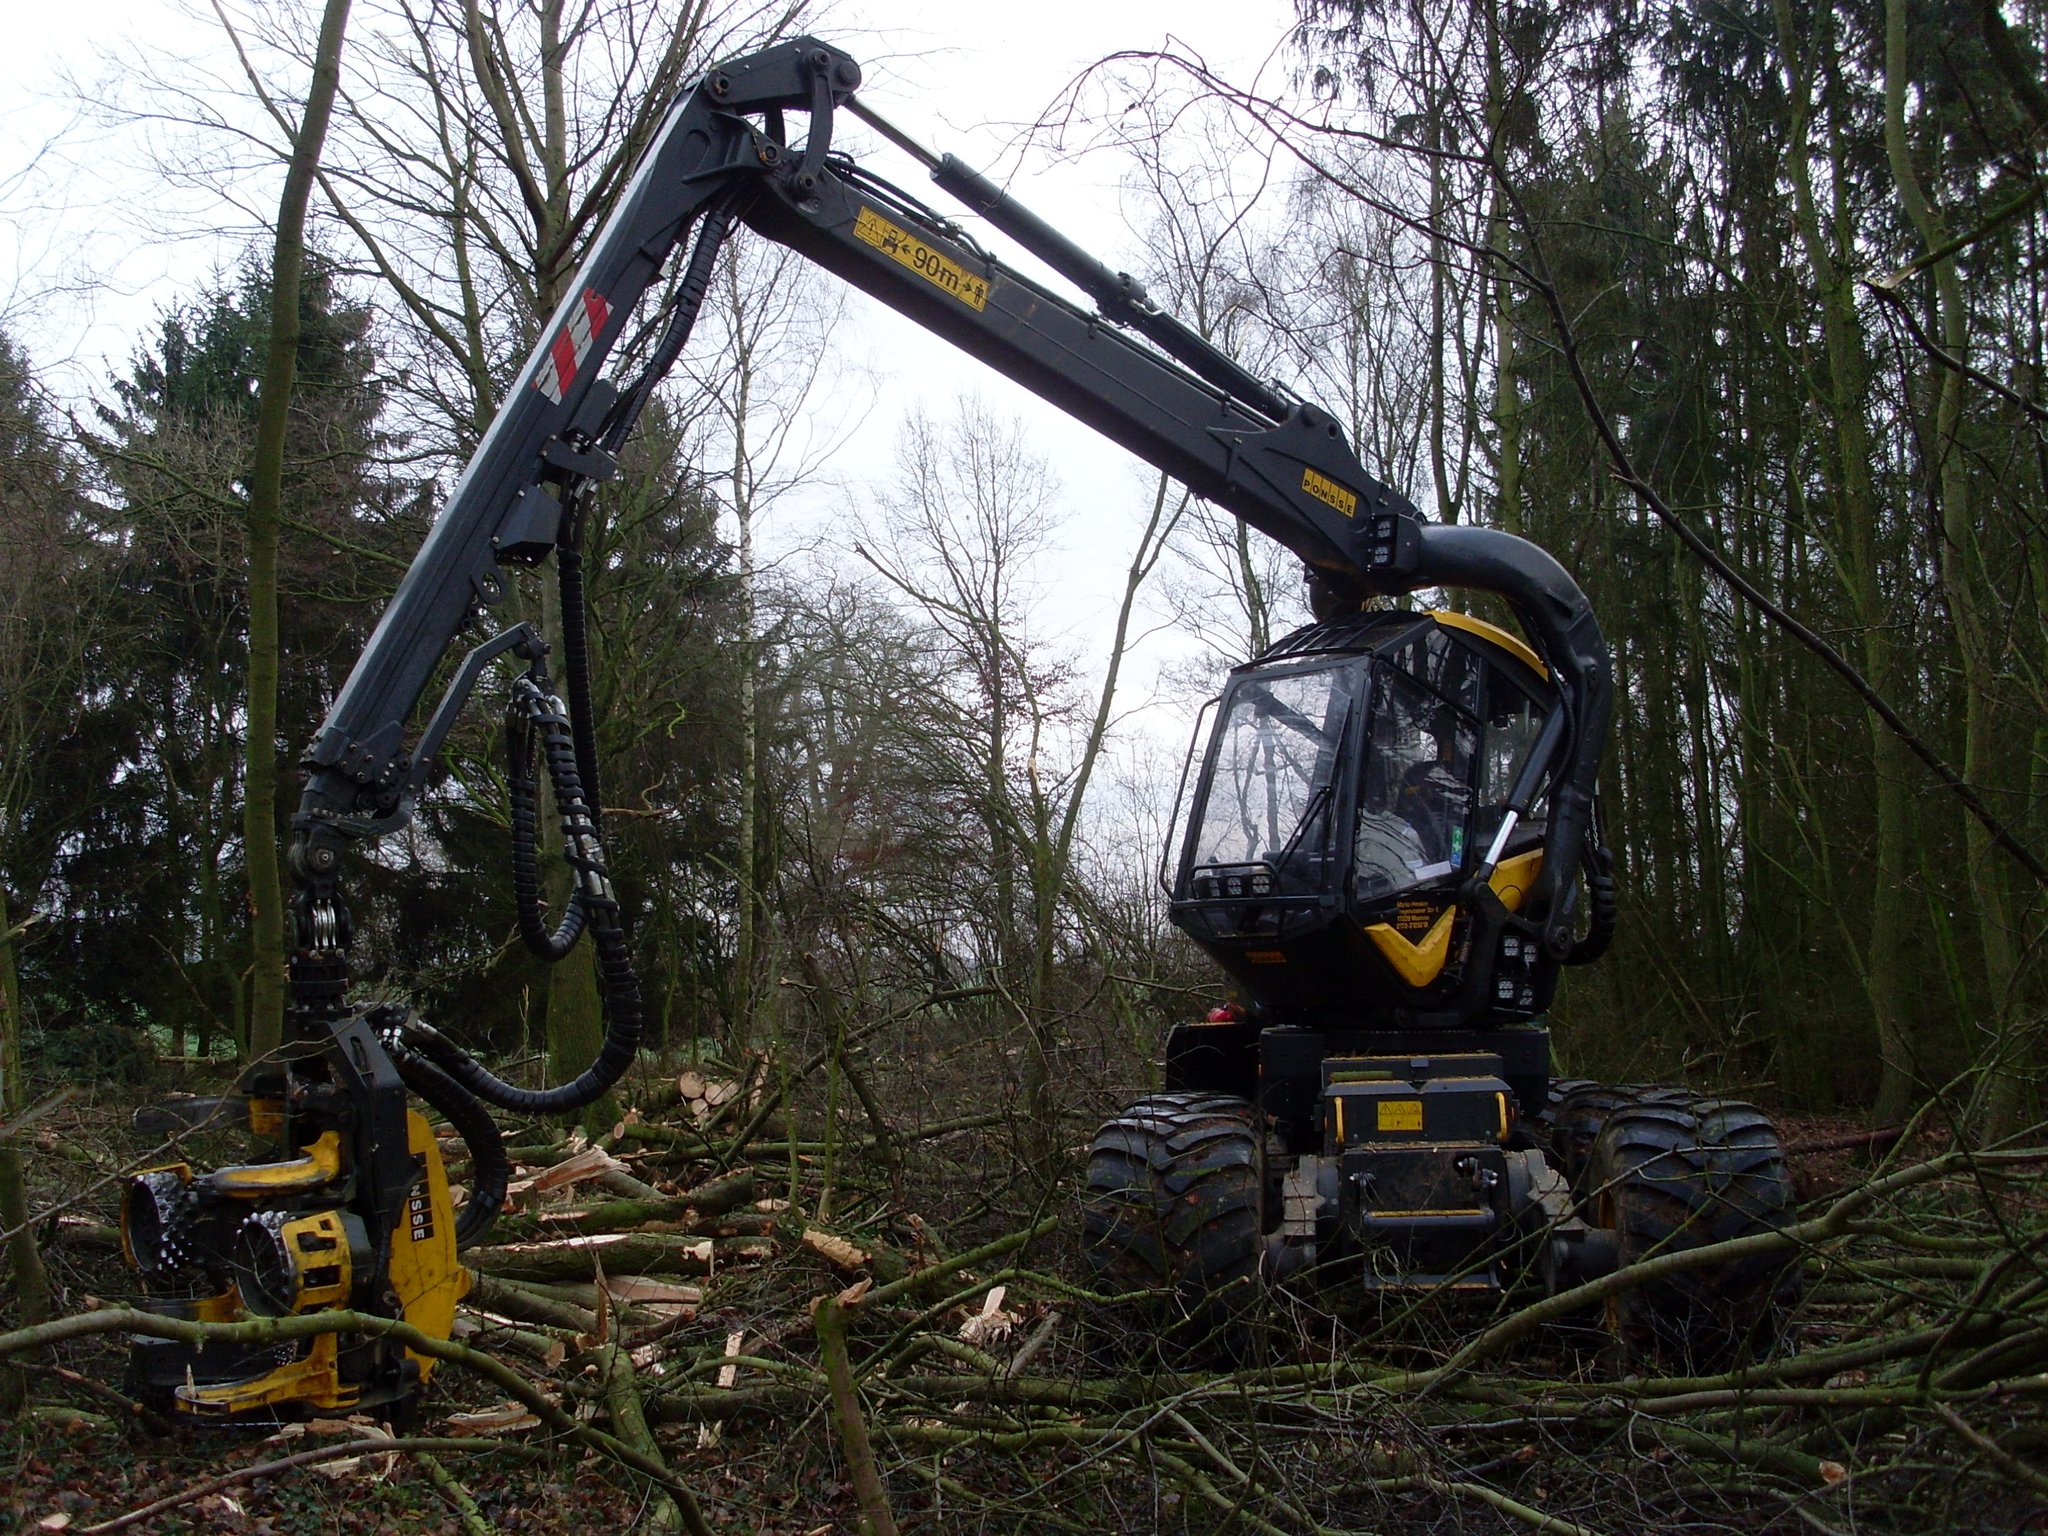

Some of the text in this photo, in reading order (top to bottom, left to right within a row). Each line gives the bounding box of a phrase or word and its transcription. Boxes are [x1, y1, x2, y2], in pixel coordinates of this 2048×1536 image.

[913, 247, 959, 290] 90m
[1303, 479, 1353, 514] PONSSE
[410, 1184, 425, 1241] NSSE
